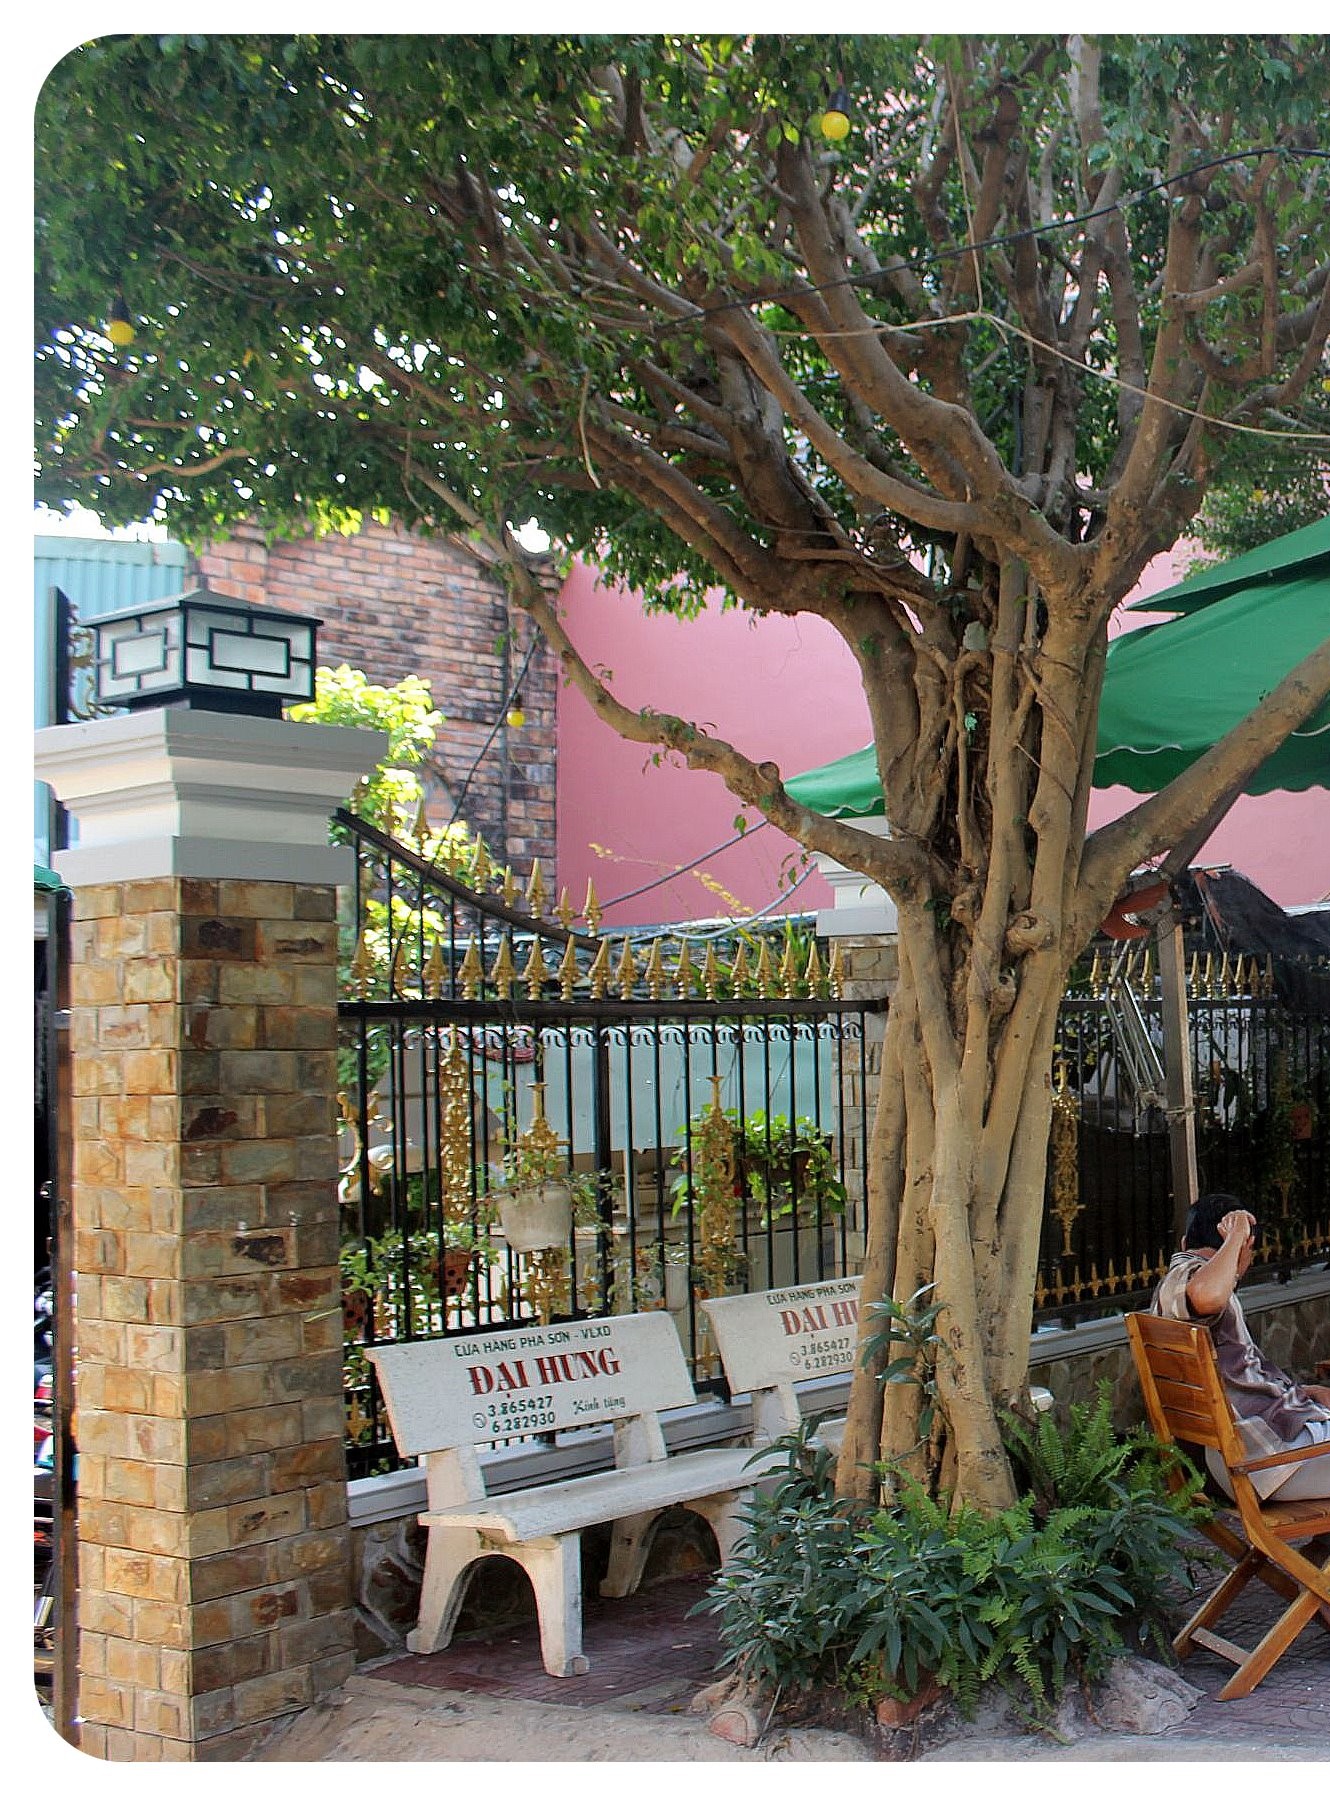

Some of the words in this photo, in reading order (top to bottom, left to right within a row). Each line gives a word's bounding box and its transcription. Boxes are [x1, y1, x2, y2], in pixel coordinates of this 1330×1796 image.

[520, 1335, 545, 1350] PHA
[487, 1395, 553, 1418] 3.865427
[491, 1411, 556, 1433] 6.282930
